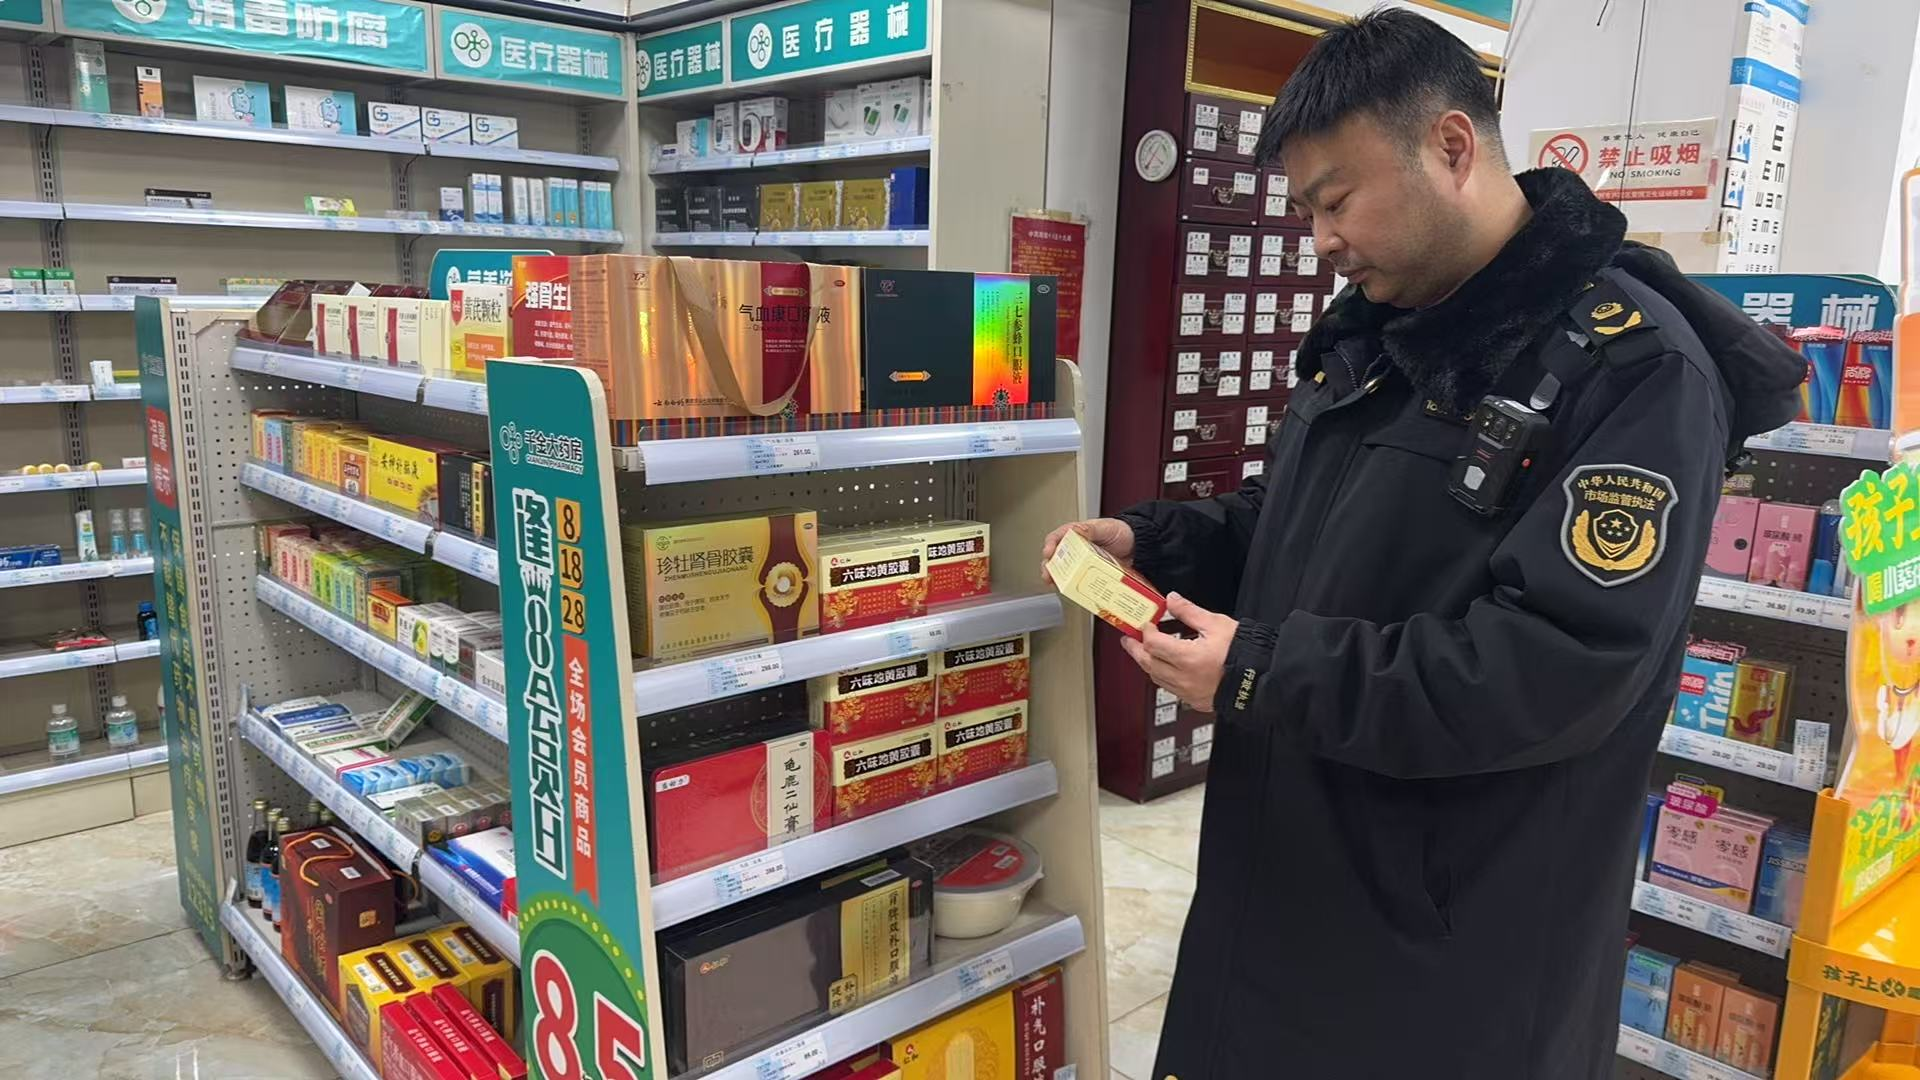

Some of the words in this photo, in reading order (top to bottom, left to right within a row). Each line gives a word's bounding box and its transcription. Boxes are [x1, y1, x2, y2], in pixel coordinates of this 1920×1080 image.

[188, 0, 388, 48] 消毒防腐
[783, 4, 910, 59] 医疗器械
[501, 37, 609, 80] 医疗器械
[654, 40, 721, 81] 医疗器械
[1597, 142, 1701, 169] 禁止吸烟
[1609, 171, 1625, 179] NO
[1630, 168, 1681, 179] SMOKING
[525, 281, 572, 312] 强骨生
[524, 429, 583, 463] 千金大药房
[550, 459, 584, 475] PHARMACY
[1577, 475, 1667, 501] 中华人民共和国
[1584, 489, 1656, 511] 市场监管执法
[563, 504, 576, 540] 8
[561, 548, 582, 583] 18
[656, 545, 754, 576] 珍牡肾骨胶囊
[842, 560, 910, 583] 六味地黄胶囊
[562, 595, 585, 629] 28
[954, 641, 1015, 665] 六味地黄胶囊
[849, 664, 918, 690] 六味地黄胶囊
[1700, 671, 1735, 730] Thin
[954, 717, 1014, 744] 六味地黄胶囊
[568, 656, 592, 859] 全场会员商品
[855, 744, 921, 774] 六味地黄胶囊
[780, 757, 802, 835] 龟鹿二仙膏
